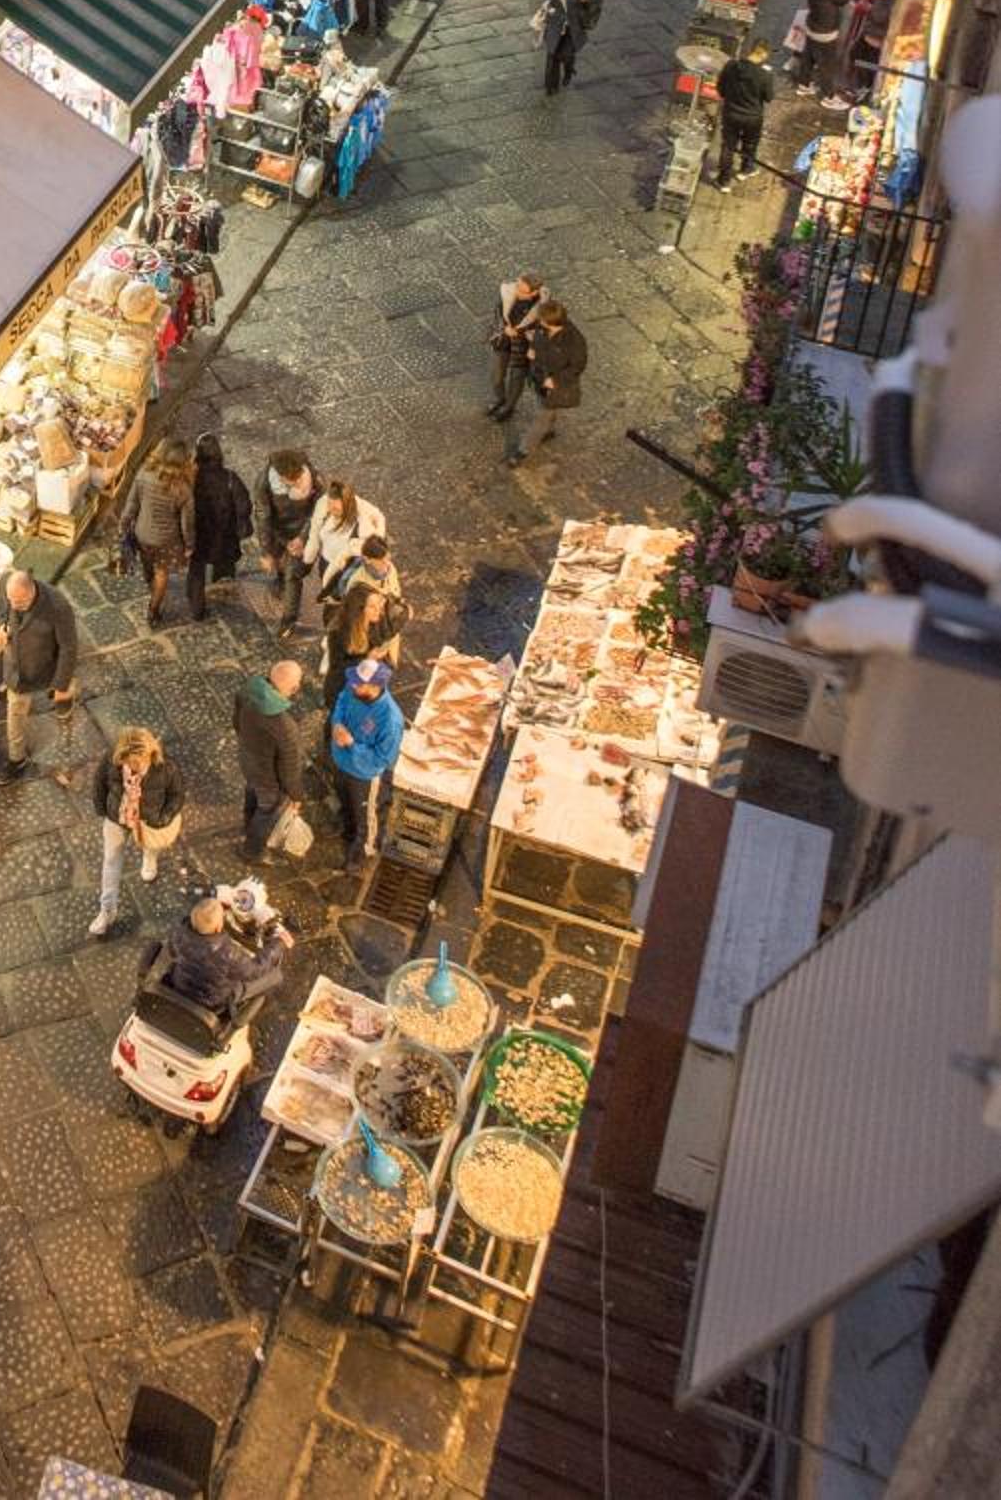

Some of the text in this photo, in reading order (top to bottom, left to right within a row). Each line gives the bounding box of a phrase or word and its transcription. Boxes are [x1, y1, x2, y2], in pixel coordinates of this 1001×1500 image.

[9, 282, 54, 345] SECCA
[64, 249, 80, 278] DA
[90, 176, 140, 248] PATRIZIA
